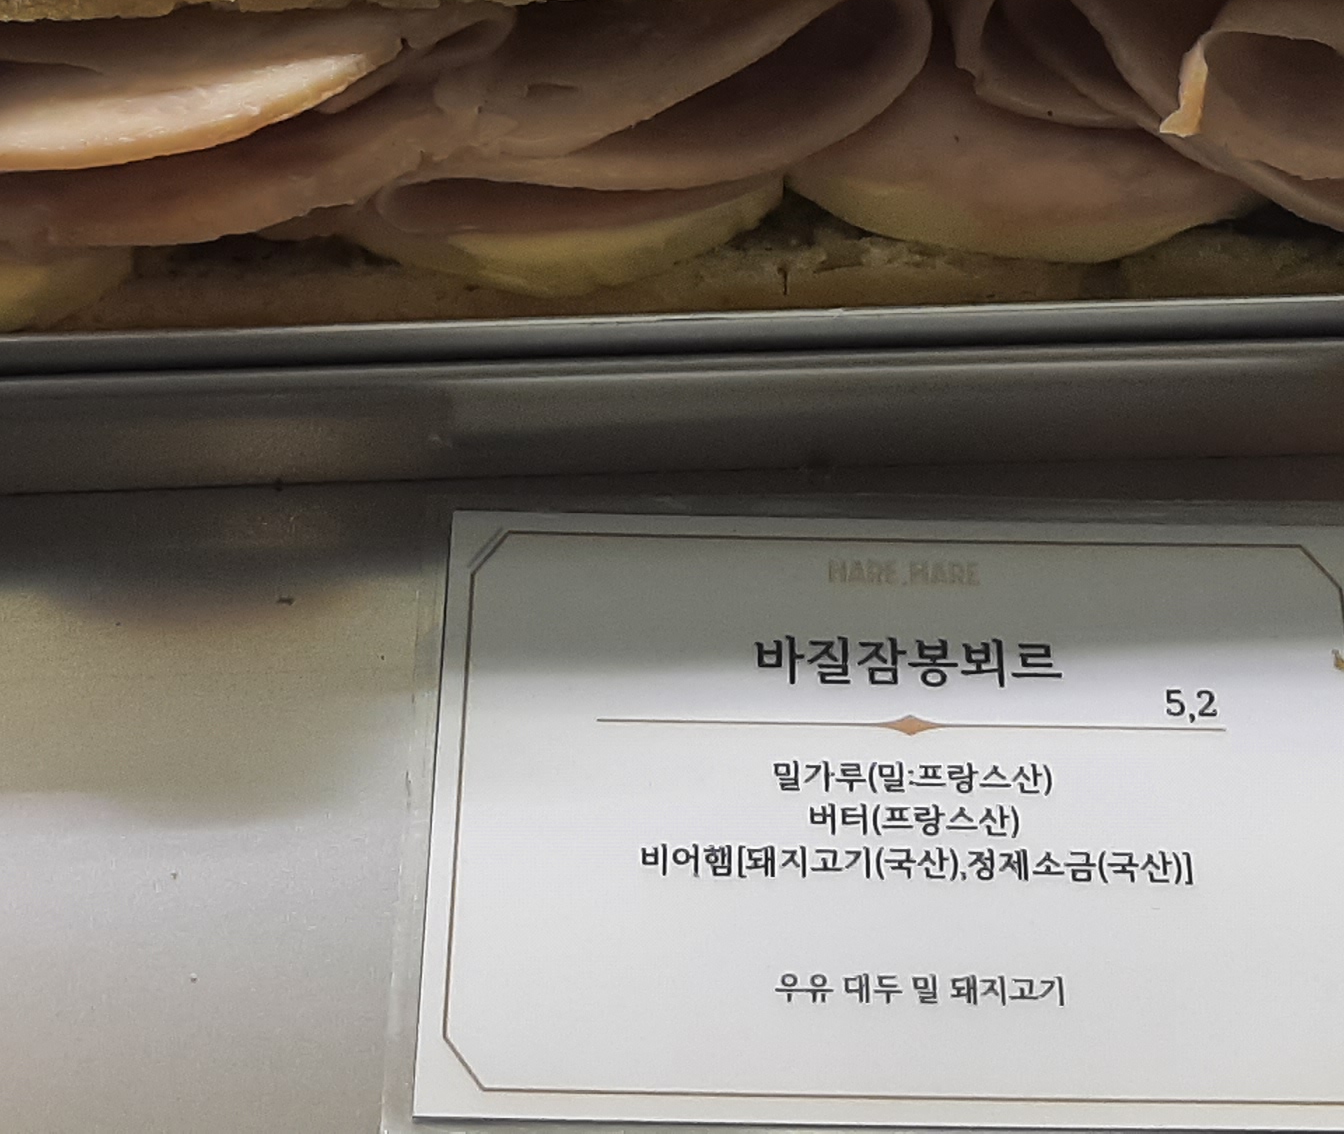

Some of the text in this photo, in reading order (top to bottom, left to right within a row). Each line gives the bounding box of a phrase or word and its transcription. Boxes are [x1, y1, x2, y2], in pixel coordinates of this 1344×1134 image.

[753, 634, 1063, 689] 바질잠봉뵈르
[1165, 689, 1218, 724] 5,2
[772, 759, 1053, 797] 밀가루(밀:프랑스산)
[809, 802, 1020, 839] 버터(프랑스산)
[774, 972, 1065, 1007] 우유 대두 밀 돼지고기
